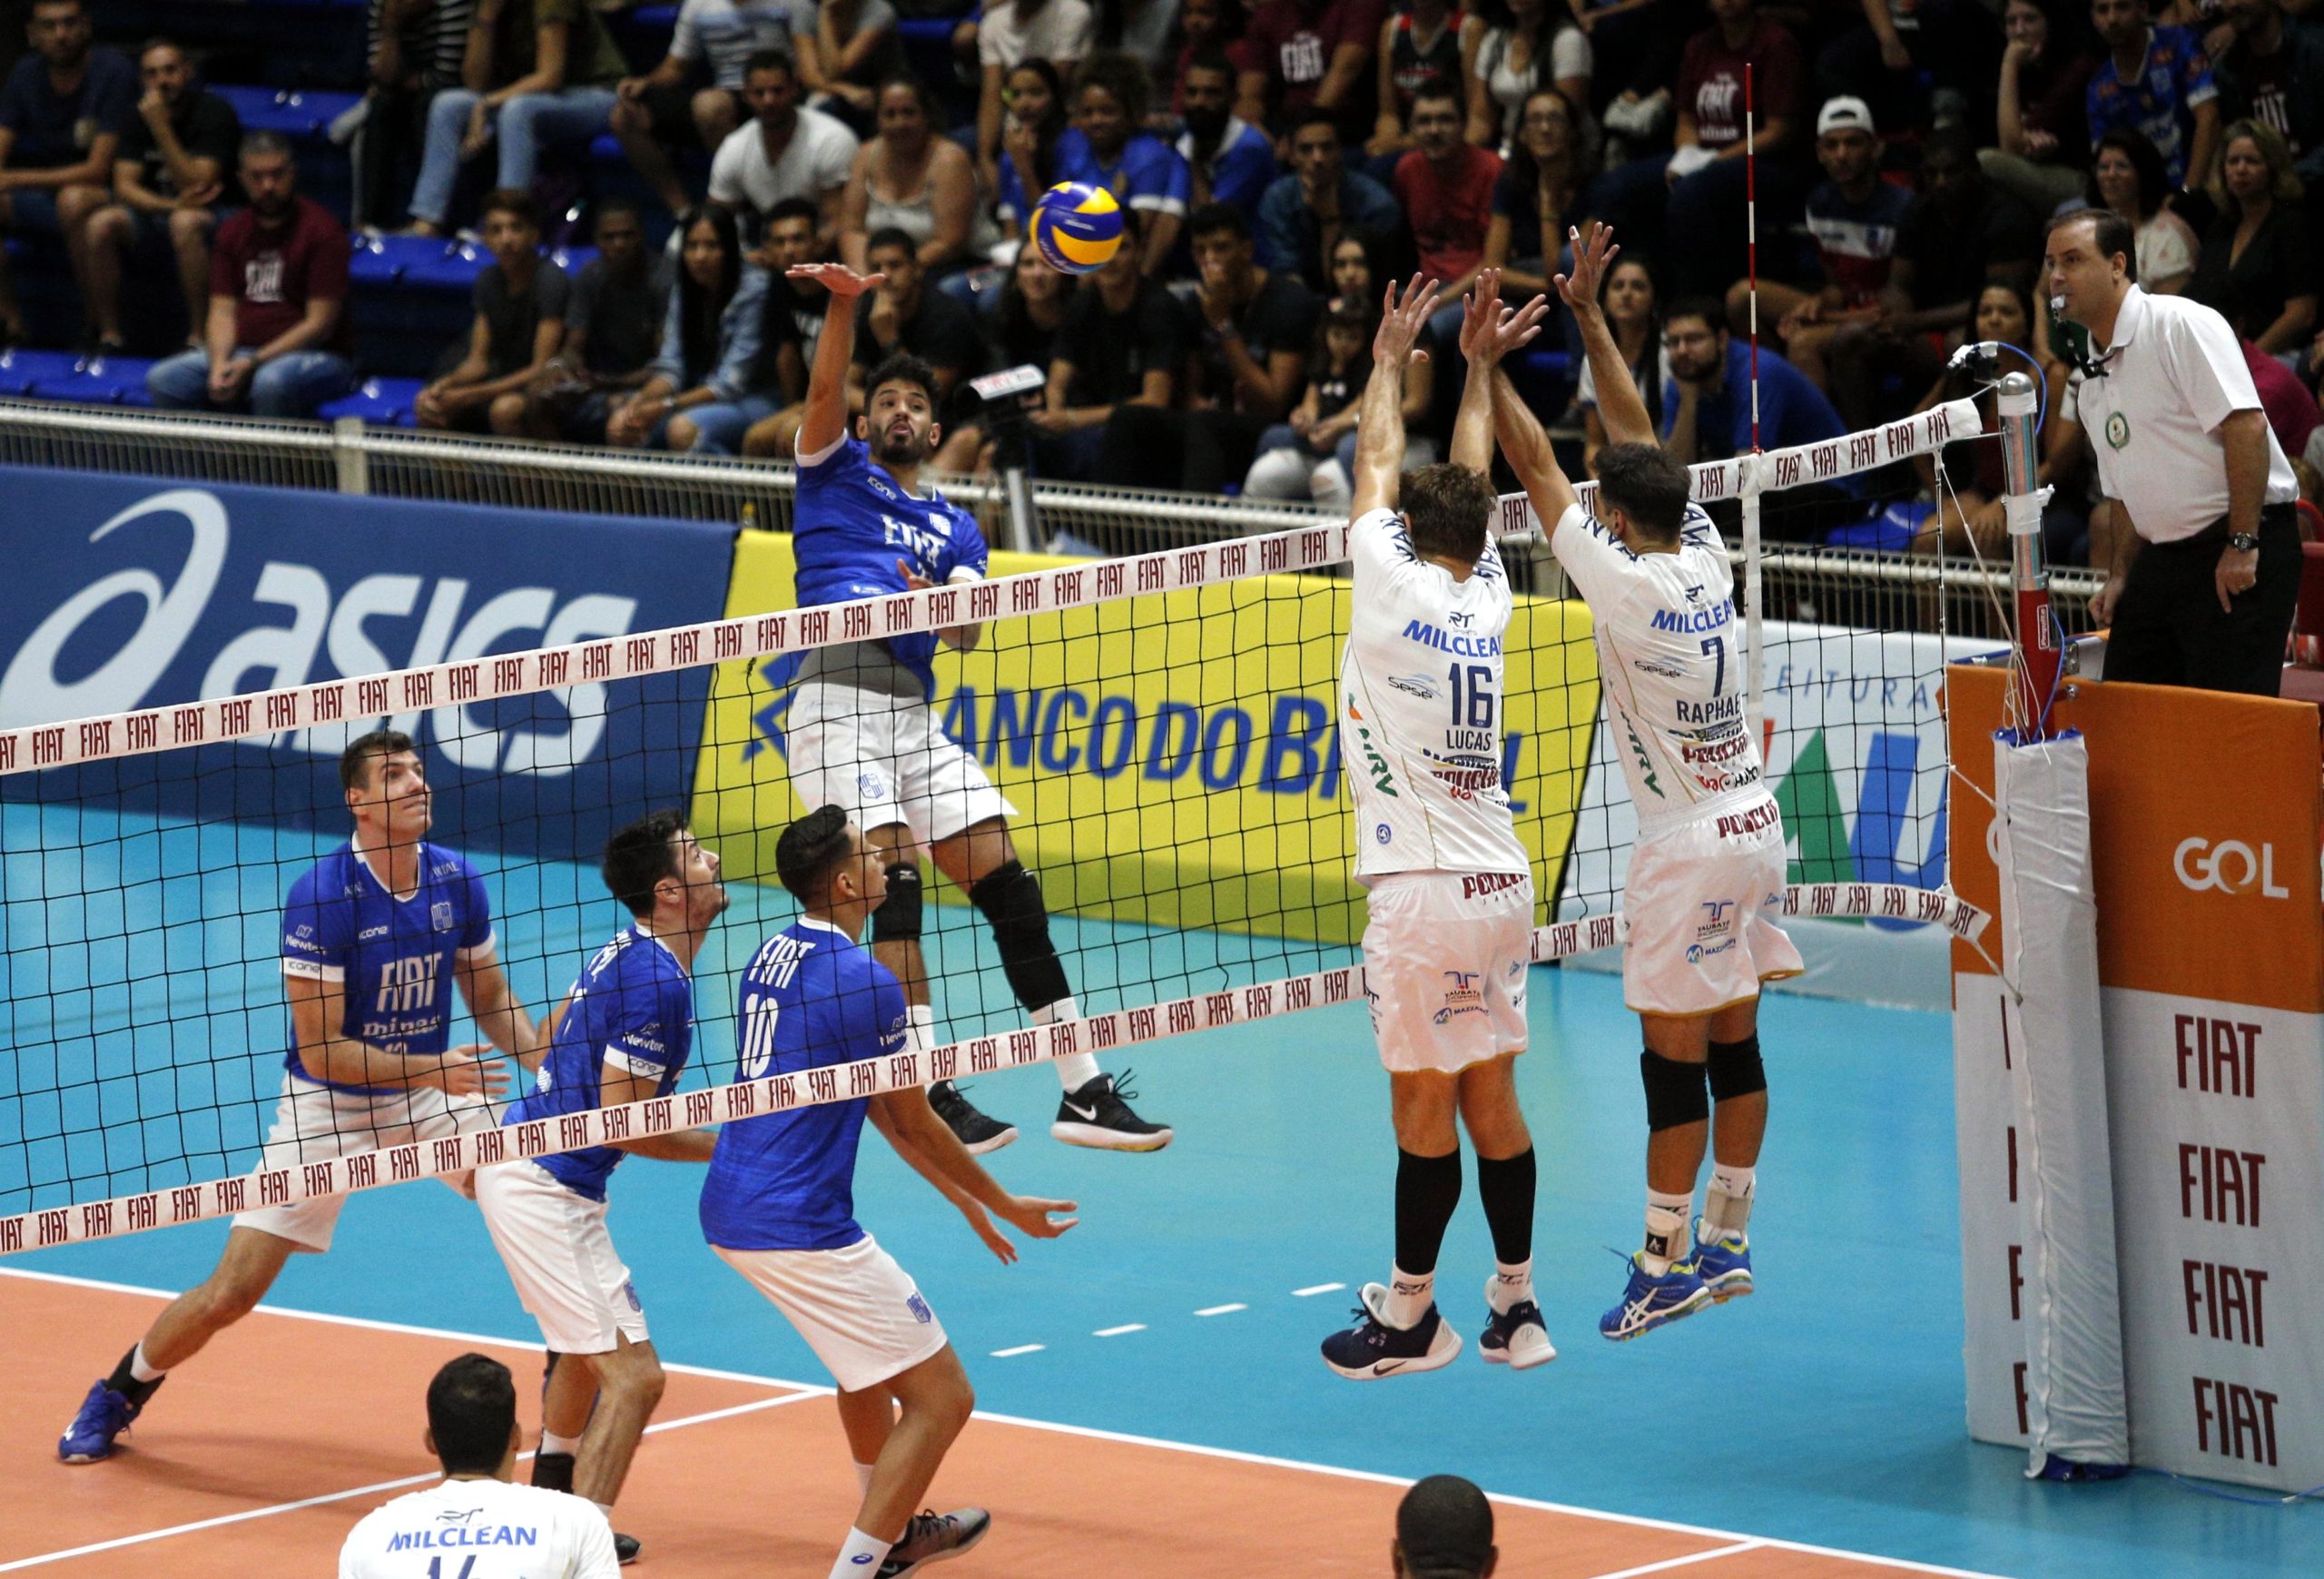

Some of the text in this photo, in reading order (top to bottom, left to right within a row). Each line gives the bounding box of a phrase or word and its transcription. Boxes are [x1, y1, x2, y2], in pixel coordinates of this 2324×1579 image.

[33, 728, 64, 765] FIAT
[80, 721, 112, 757] FIAT
[127, 715, 159, 750] FIAT
[174, 707, 204, 743] FIAT
[221, 700, 251, 736] FIAT
[267, 693, 298, 728] FIAT
[312, 686, 343, 721] FIAT
[359, 678, 389, 714] FIAT
[405, 672, 433, 707] FIAT
[449, 665, 478, 700] FIAT
[495, 658, 524, 693] FIAT
[539, 651, 569, 686] FIAT
[583, 644, 612, 679] FIAT
[627, 637, 655, 672] FIAT
[671, 630, 700, 665] FIAT
[714, 624, 743, 658] FIAT
[758, 617, 786, 651] FIAT
[801, 611, 829, 645] FIAT
[844, 604, 872, 638] FIAT
[887, 597, 914, 632] FIAT
[929, 591, 957, 625] FIAT
[971, 585, 1000, 618] FIAT
[1013, 577, 1040, 612] FIAT
[1055, 571, 1082, 605] FIAT
[1098, 564, 1125, 597] FIAT
[1138, 558, 1166, 591] FIAT
[1179, 550, 1206, 585] FIAT
[1221, 544, 1246, 577] FIAT
[1261, 538, 1287, 571] FIAT
[1302, 530, 1327, 564] FIAT
[1502, 497, 1528, 531] FIAT
[1581, 488, 1598, 517] FI
[1699, 465, 1725, 498] FIAT
[1776, 453, 1801, 487] FIAT
[1812, 444, 1838, 478] FIAT
[1851, 434, 1876, 468] FIAT
[1886, 421, 1915, 457] FIAT
[1449, 663, 1493, 728] 16
[1700, 636, 1724, 697] 7
[1777, 663, 1929, 711] EITURA
[944, 684, 1137, 779] ANCO
[1143, 698, 1251, 792] DO
[1446, 729, 1493, 752] LUCAS
[1676, 692, 1741, 725] RAPHAE
[2173, 836, 2289, 899] GOL
[376, 952, 443, 1013] FIAT
[748, 933, 816, 989] FIAT
[1, 1219, 24, 1249] IAT
[39, 1210, 67, 1243] FIAT
[84, 1203, 113, 1235] FIAT
[128, 1196, 157, 1227] FIAT
[172, 1189, 201, 1219] FIAT
[217, 1182, 243, 1210] FIAT
[261, 1173, 288, 1203] FIAT
[304, 1165, 332, 1195] FIAT
[348, 1156, 375, 1187] FIAT
[390, 1148, 419, 1179] FIAT
[434, 1140, 461, 1171] FIAT
[477, 1131, 503, 1164] FIAT
[517, 1123, 546, 1156] FIAT
[560, 1115, 587, 1149] FIAT
[602, 1107, 630, 1140] FIAT
[644, 1100, 671, 1133] FIAT
[686, 1091, 713, 1125] FIAT
[727, 1084, 754, 1118] FIAT
[769, 1076, 795, 1110] FIAT
[808, 1069, 836, 1101] FIAT
[849, 1061, 876, 1095] FIAT
[890, 1054, 917, 1088] FIAT
[931, 1045, 958, 1080] FIAT
[970, 1038, 997, 1072] FIAT
[1010, 1030, 1037, 1064] FIAT
[1050, 1022, 1077, 1057] FIAT
[1089, 1015, 1116, 1049] FIAT
[1128, 1008, 1155, 1041] FIAT
[1168, 1001, 1195, 1033] FIAT
[1206, 993, 1233, 1025] FIAT
[1246, 986, 1272, 1018] FIAT
[1285, 978, 1311, 1011] FIAT
[1324, 971, 1349, 1002] FIAT
[1552, 924, 1578, 955] FIAT
[1590, 916, 1615, 948] FIAT
[1812, 885, 1837, 915] FIAT
[1846, 885, 1872, 915] FIAT
[1918, 892, 1947, 921] FIAT
[742, 993, 779, 1079] 10
[2174, 1013, 2262, 1099] FIAT
[2179, 1142, 2265, 1228] FIAT
[2182, 1259, 2268, 1347] FIAT
[2192, 1376, 2279, 1467] FIAT
[386, 1525, 537, 1554] MILCLEAN
